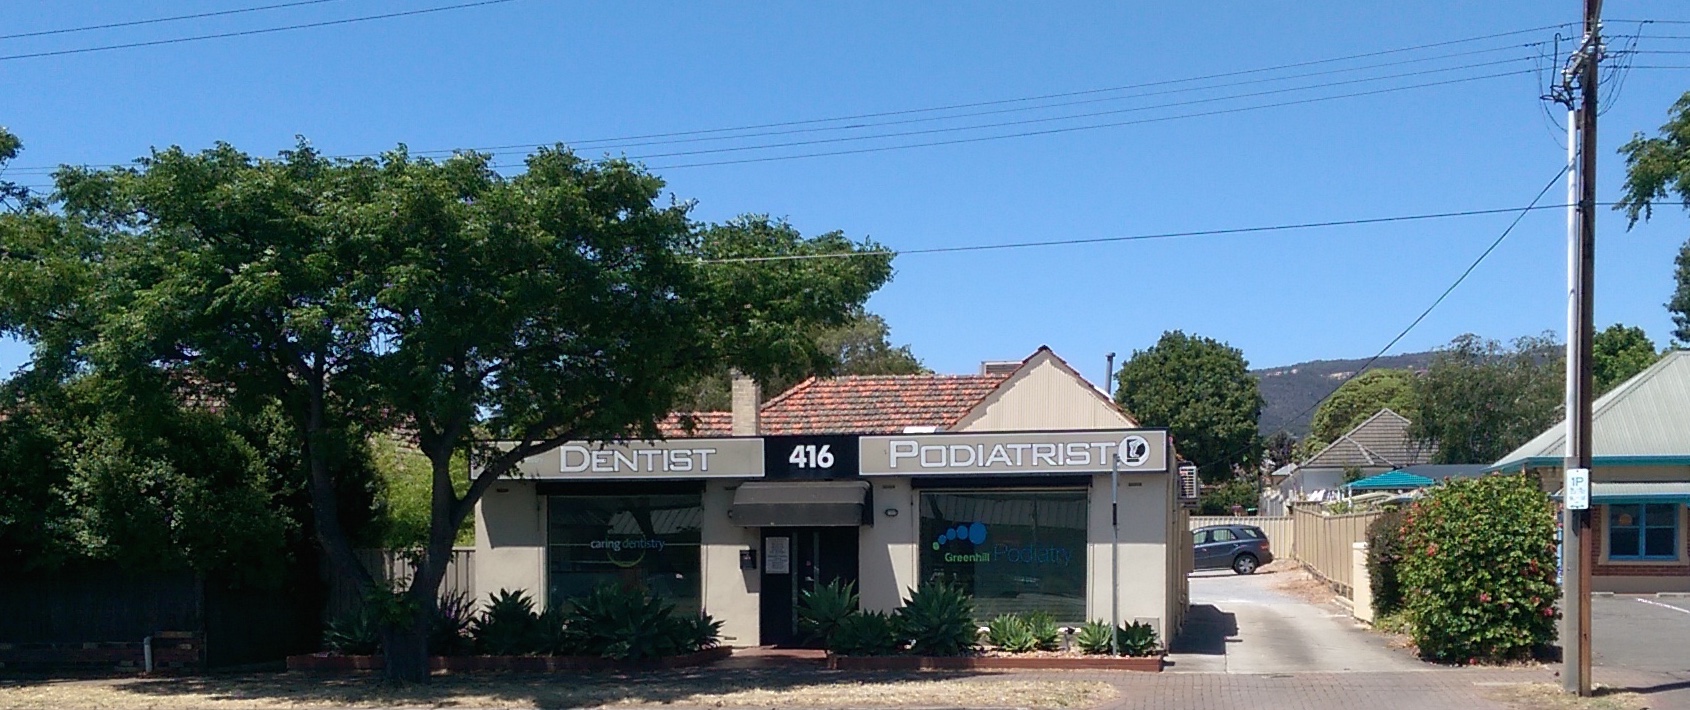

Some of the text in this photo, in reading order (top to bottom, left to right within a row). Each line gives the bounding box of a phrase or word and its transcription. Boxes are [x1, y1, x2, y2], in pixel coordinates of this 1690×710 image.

[559, 445, 717, 472] DENTIST
[788, 444, 835, 469] 416
[889, 440, 1116, 469] PODIATRIST
[1571, 476, 1584, 486] 1P
[590, 538, 666, 552] caring dentistry
[944, 543, 1072, 566] Greenhill Podiatry
